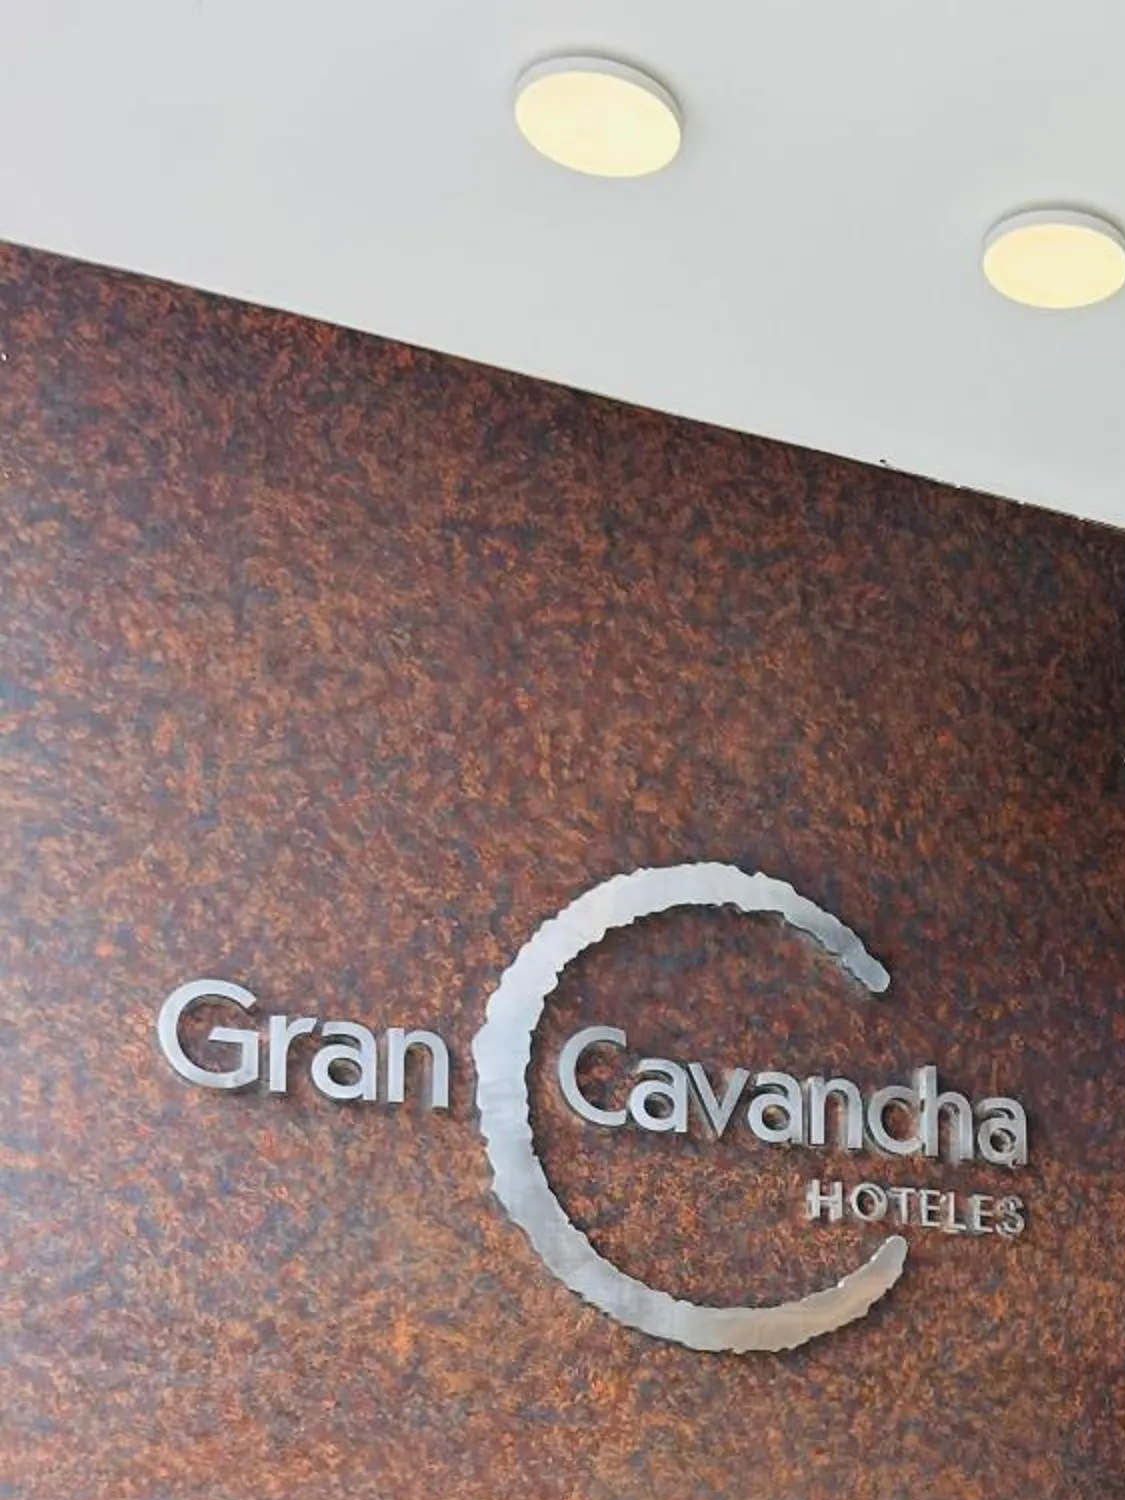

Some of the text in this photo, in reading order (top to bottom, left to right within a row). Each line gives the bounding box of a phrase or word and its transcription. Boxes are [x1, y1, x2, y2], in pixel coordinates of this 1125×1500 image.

[157, 978, 1028, 1166] Gran Cavancha
[806, 1179, 1026, 1235] HOTELES
